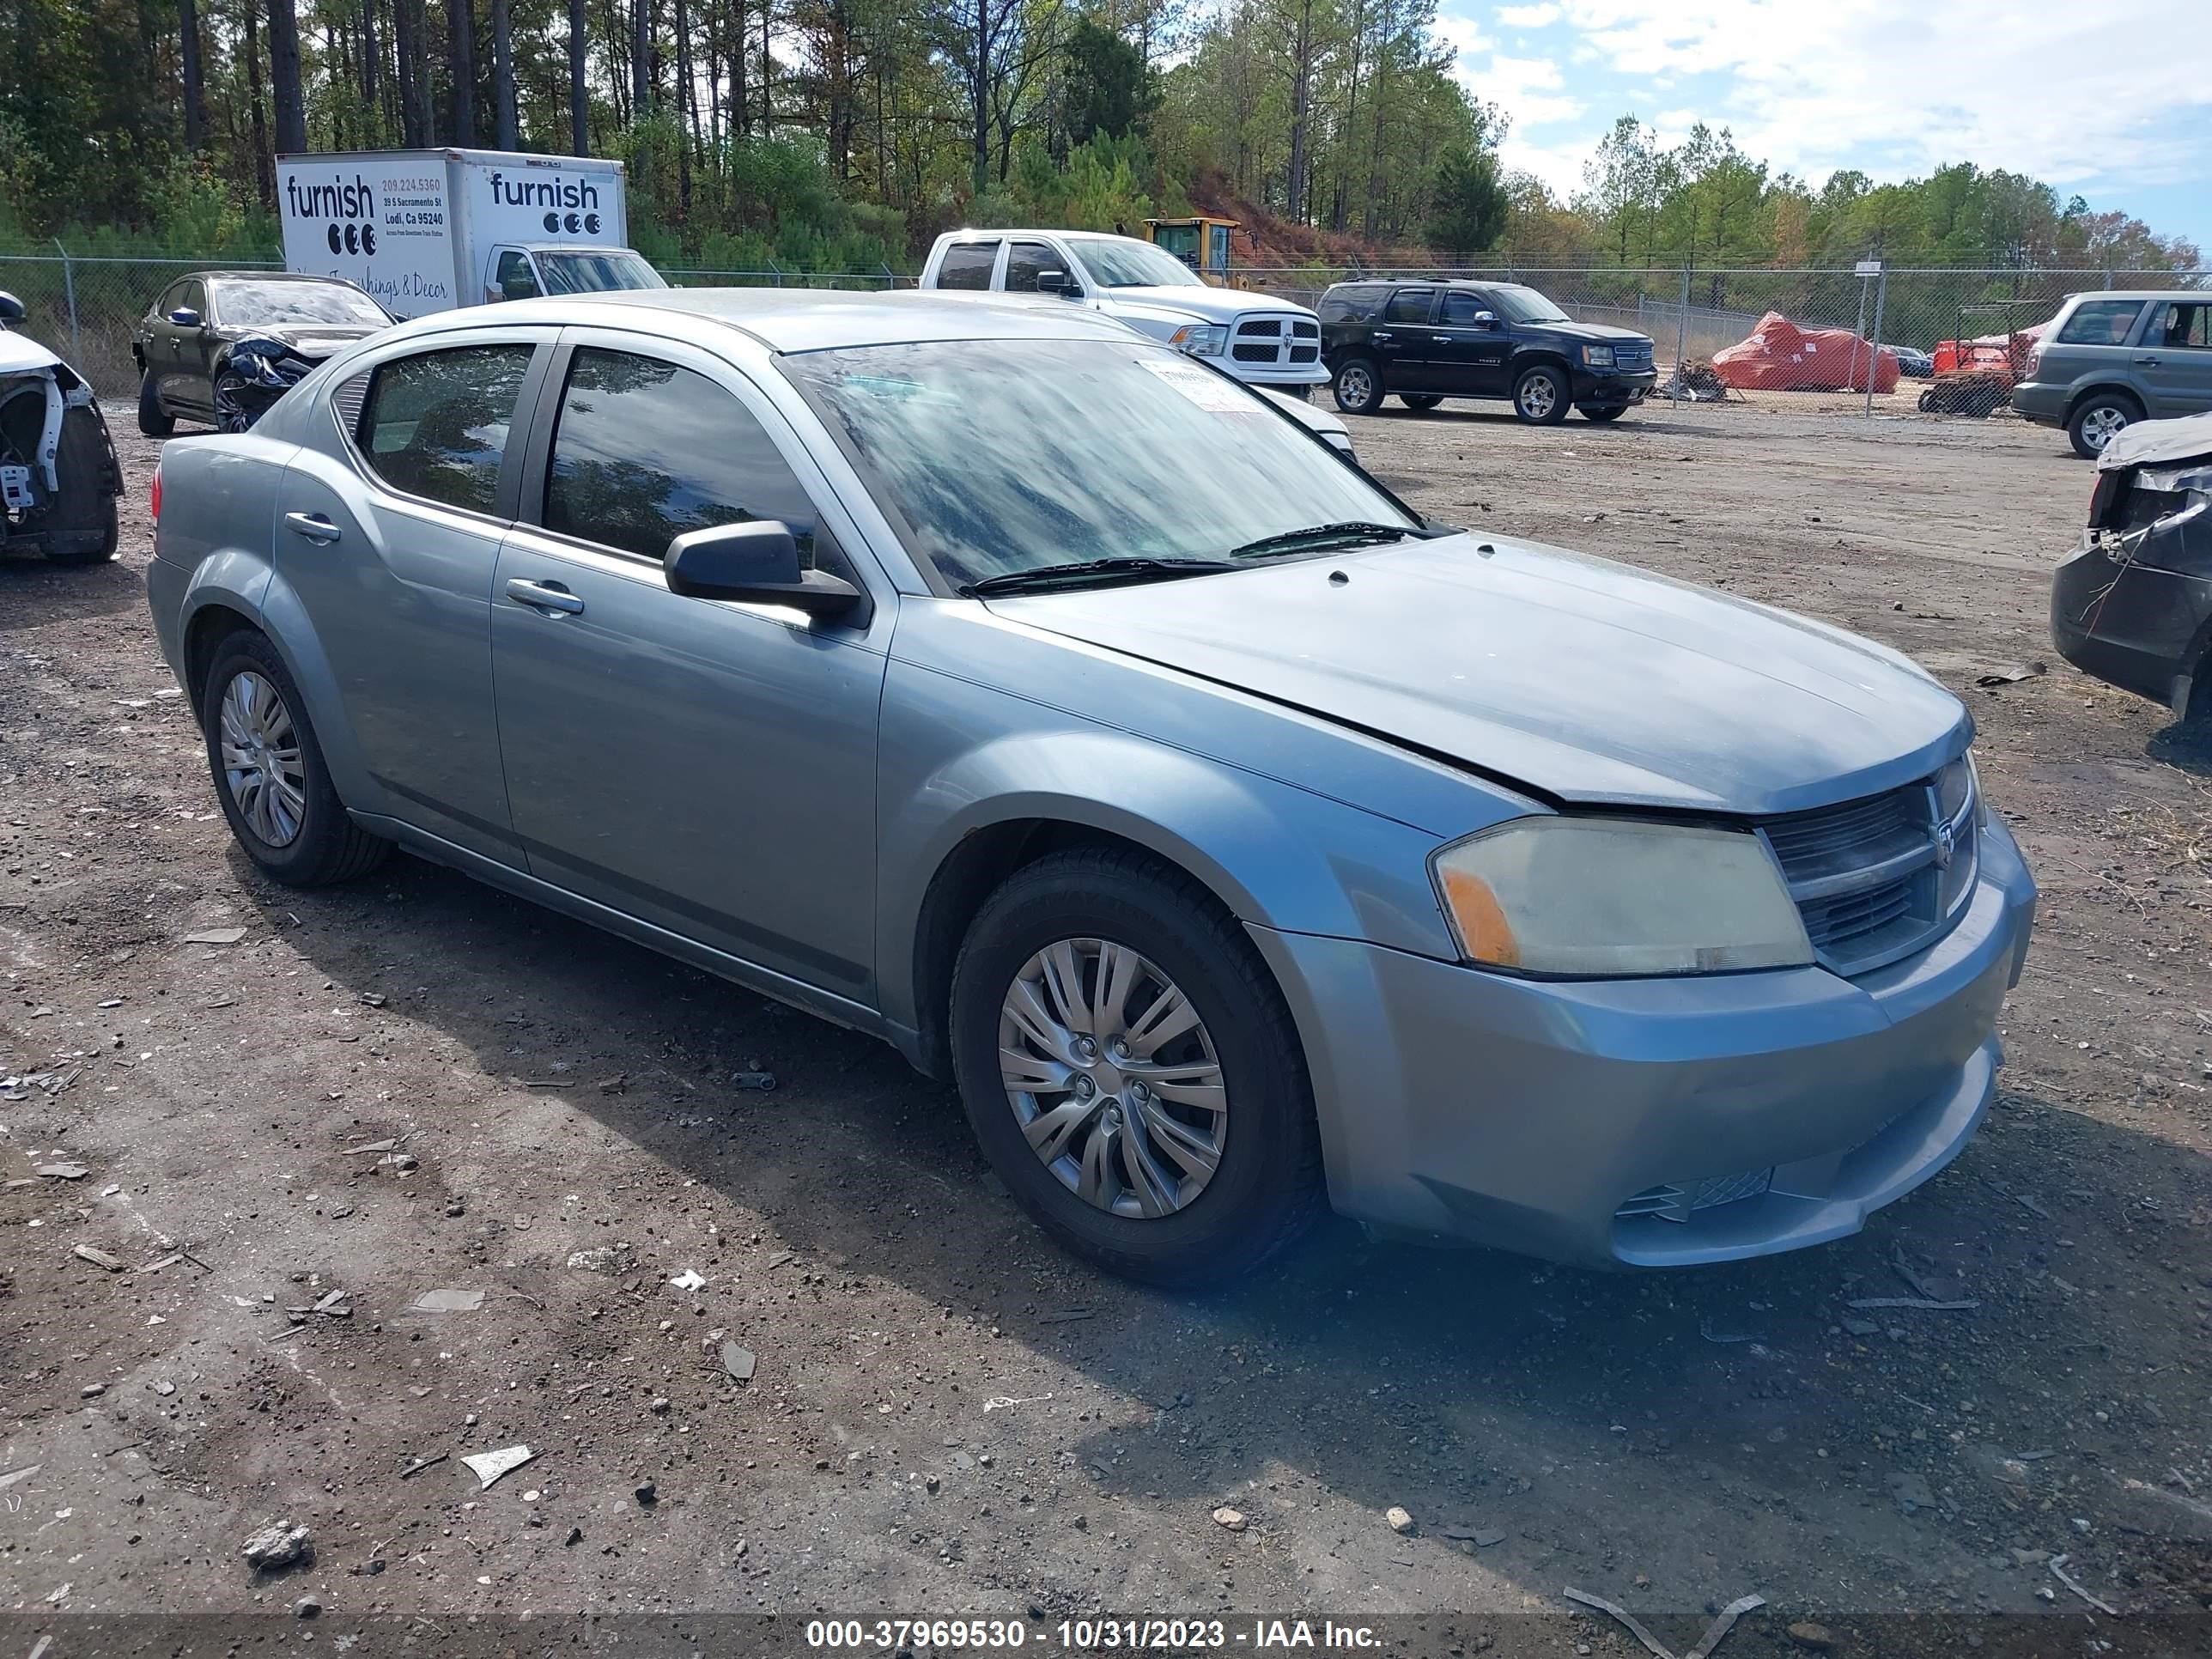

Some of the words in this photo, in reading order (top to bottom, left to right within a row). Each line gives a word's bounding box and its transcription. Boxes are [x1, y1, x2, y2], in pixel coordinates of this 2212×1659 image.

[287, 174, 374, 218] furnish
[382, 179, 441, 191] 209.224.5360
[490, 173, 599, 210] furnish
[383, 198, 391, 207] 39
[392, 198, 397, 207] S
[397, 197, 434, 207] Sacramento
[434, 197, 442, 207] St
[385, 212, 404, 227] Lodi,
[405, 213, 416, 224] Ca
[417, 213, 443, 225] 95240
[403, 274, 410, 296] &
[412, 270, 448, 299] Decor
